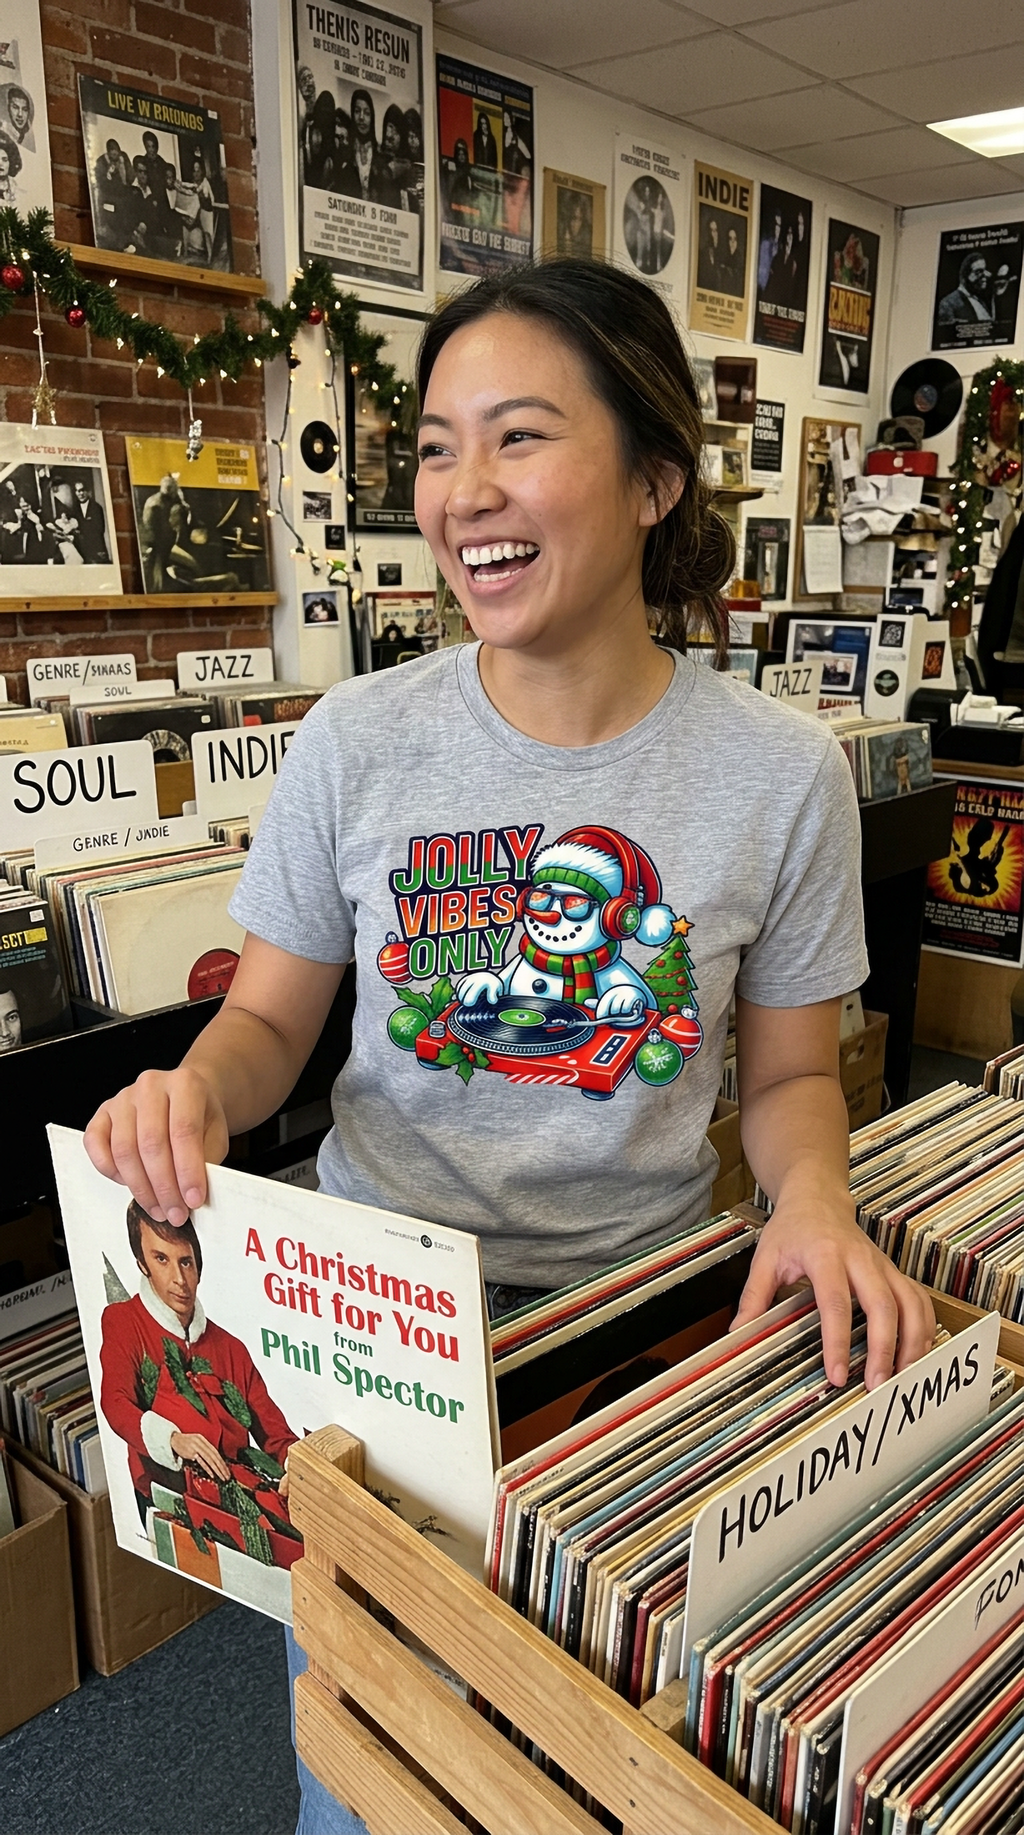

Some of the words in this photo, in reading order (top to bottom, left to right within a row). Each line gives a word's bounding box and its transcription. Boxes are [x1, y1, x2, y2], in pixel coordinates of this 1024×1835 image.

[306, 4, 360, 46] THENIS
[365, 25, 410, 64] RESUN
[107, 90, 135, 113] LIVE
[698, 172, 749, 212] INDIE
[104, 686, 132, 697] SOUL
[194, 655, 254, 681] JAZZ
[770, 668, 812, 698] JAZZ
[13, 754, 137, 814] SOUL
[394, 826, 541, 893] JOLLY
[398, 885, 516, 938] VIBES
[409, 928, 511, 979] ONLY
[245, 1227, 266, 1262] A
[275, 1236, 457, 1319] Christmas
[264, 1273, 321, 1319] Gift
[332, 1292, 383, 1336] for
[391, 1309, 460, 1363] You
[333, 1331, 374, 1357] from
[260, 1327, 321, 1376] Phil
[333, 1353, 465, 1424] Spector
[718, 1343, 980, 1563] HOLIDAY/XMAS
